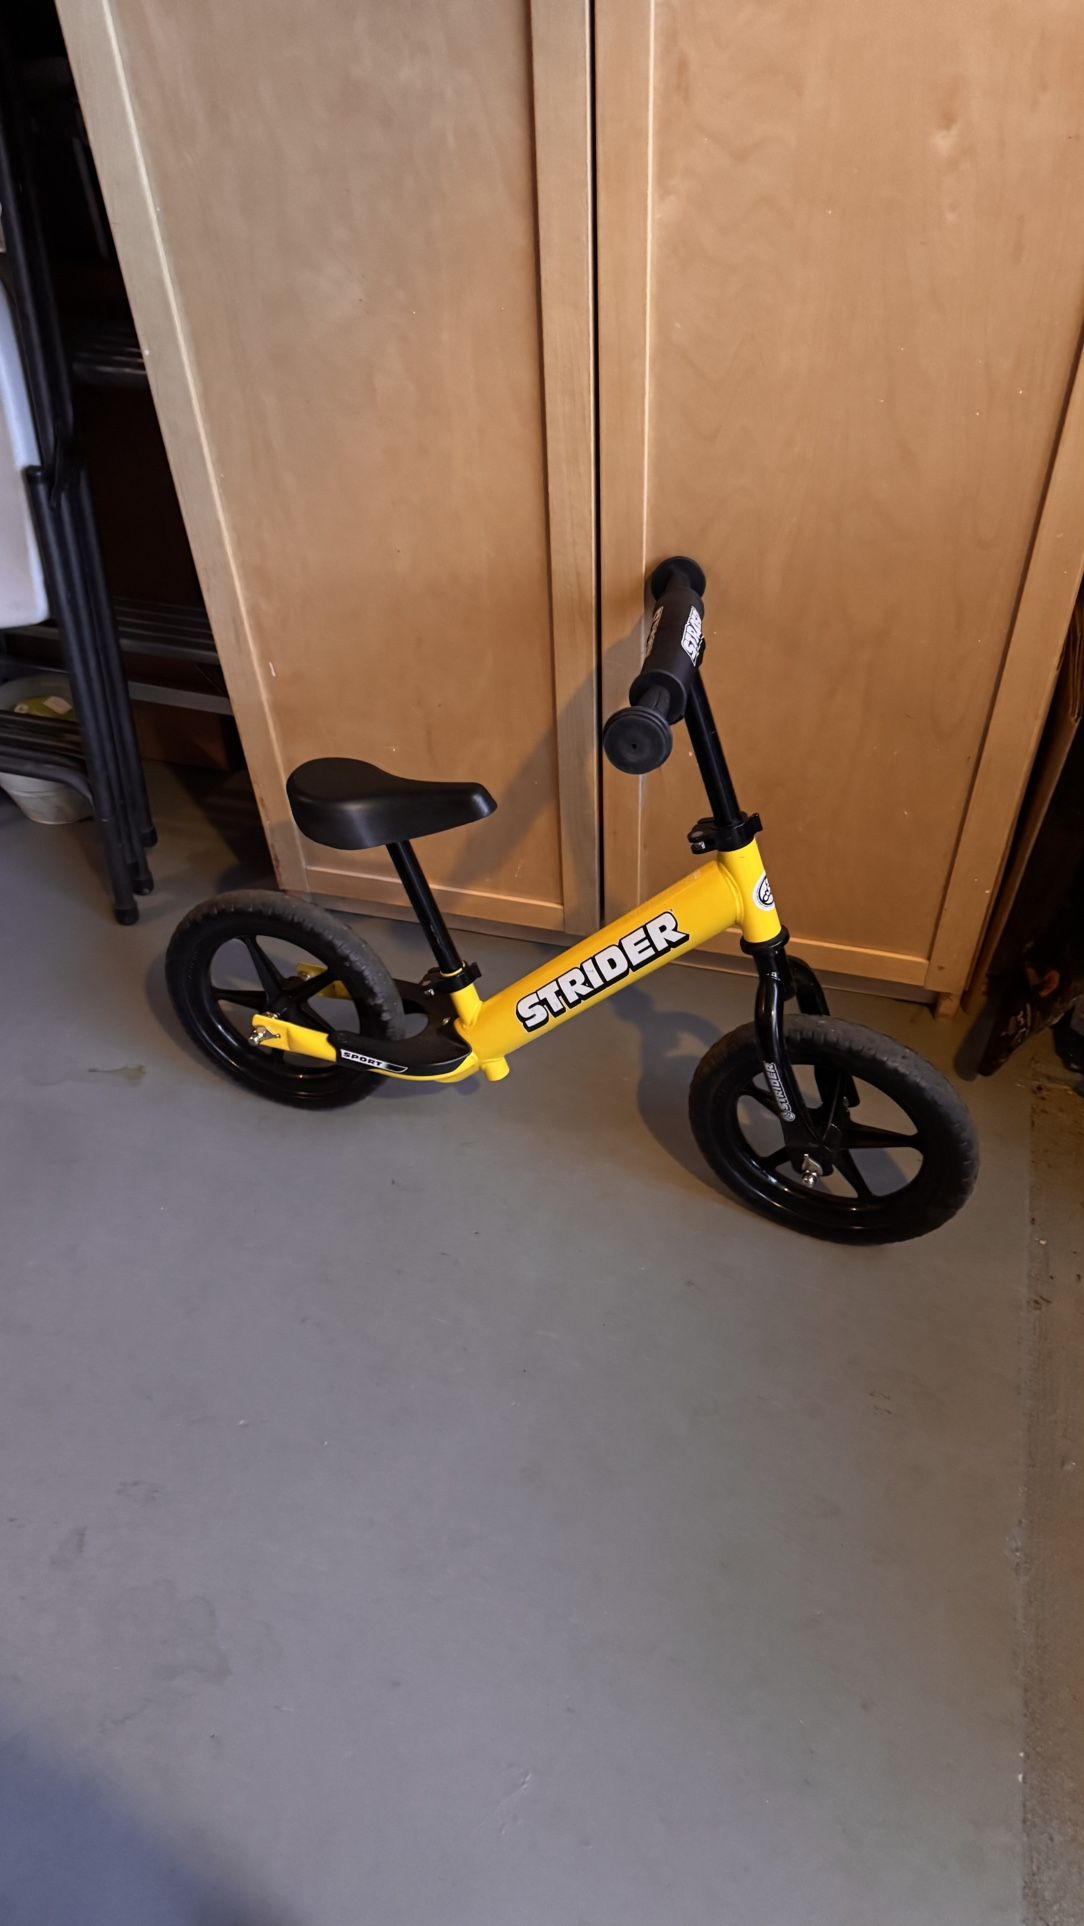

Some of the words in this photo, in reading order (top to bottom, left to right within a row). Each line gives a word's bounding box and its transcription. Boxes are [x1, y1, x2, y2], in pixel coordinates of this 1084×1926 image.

[516, 911, 690, 1032] STRIDER
[343, 1051, 383, 1066] SPORT
[764, 1062, 790, 1111] STRIDER
